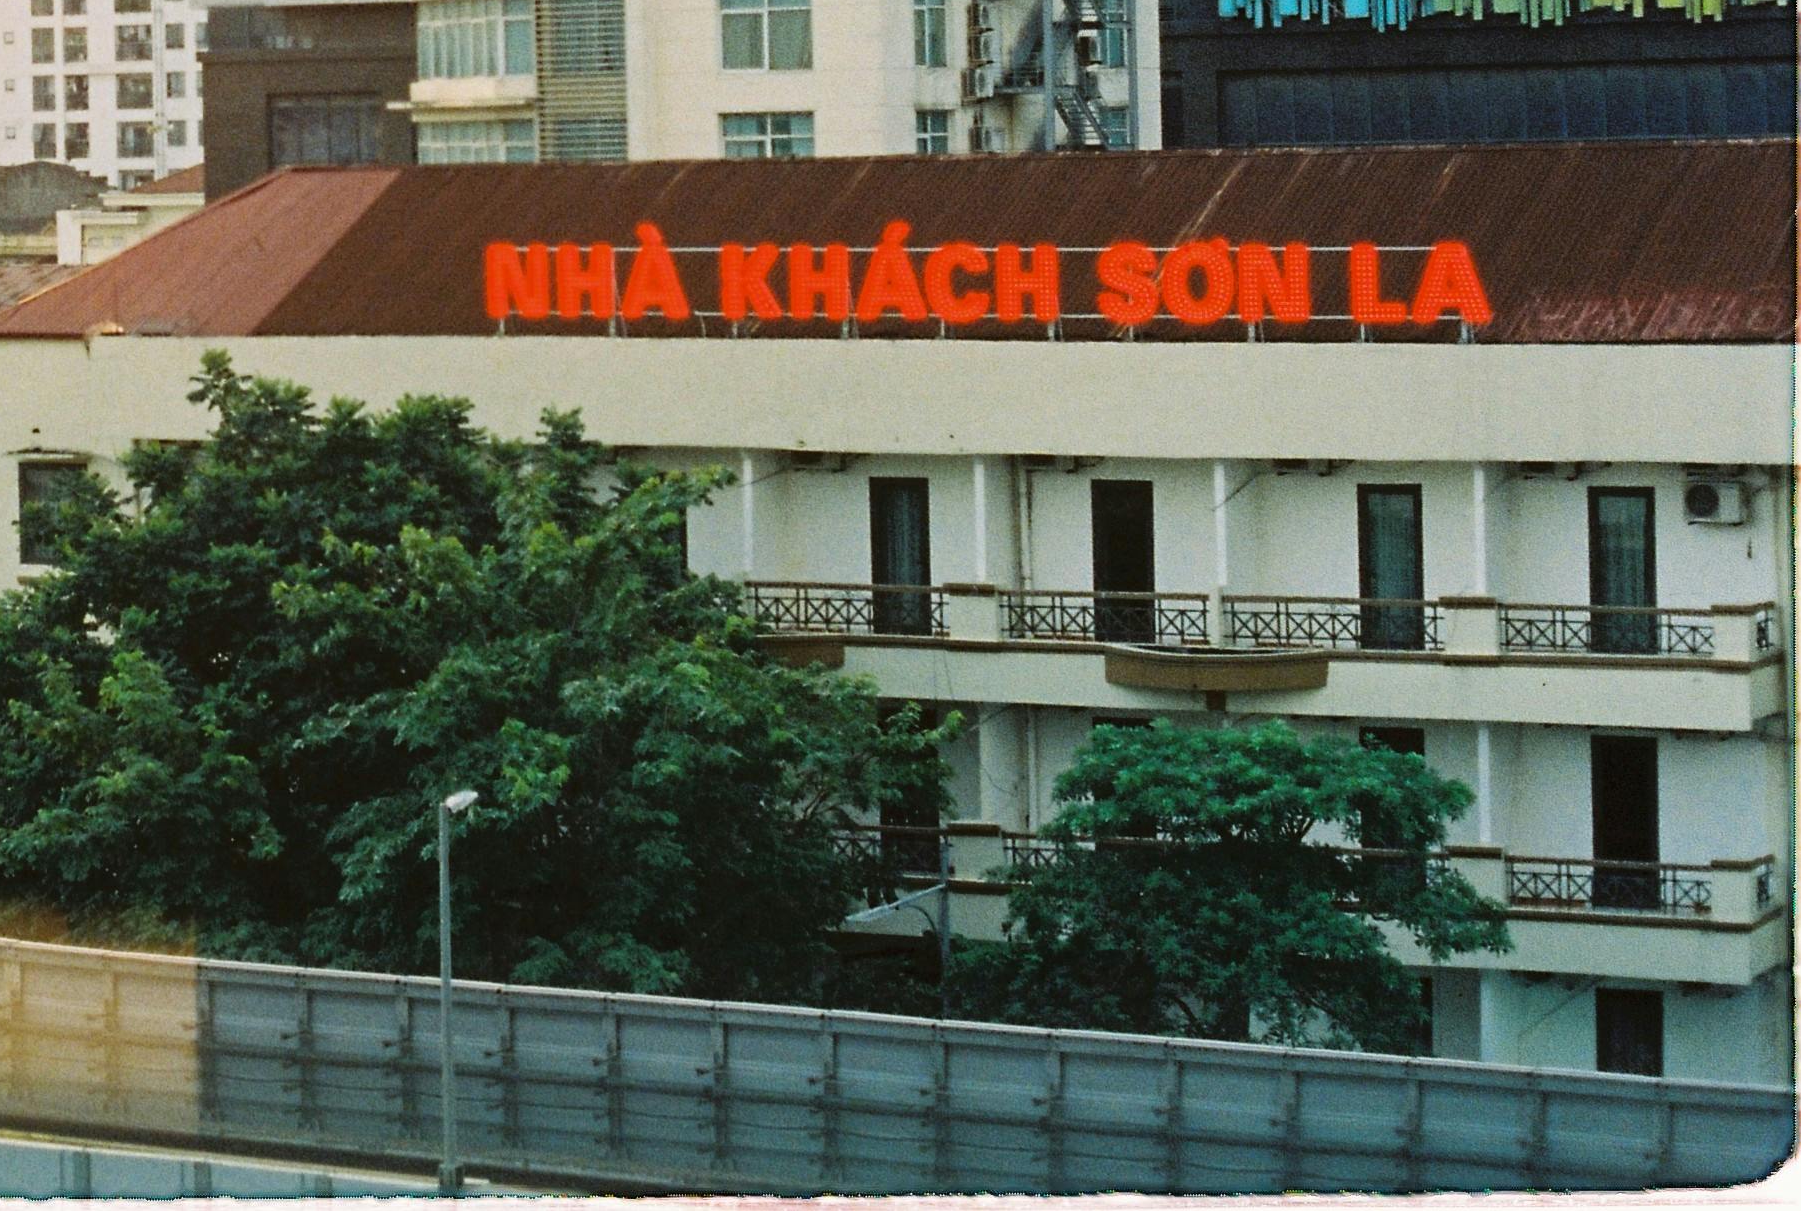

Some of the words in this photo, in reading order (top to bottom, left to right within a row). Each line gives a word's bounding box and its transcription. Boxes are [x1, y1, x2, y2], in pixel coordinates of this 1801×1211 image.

[485, 223, 690, 320] NHÀ
[718, 221, 1060, 323] KHÁCH
[1097, 237, 1311, 327] SƠN
[1349, 241, 1492, 324] LA
